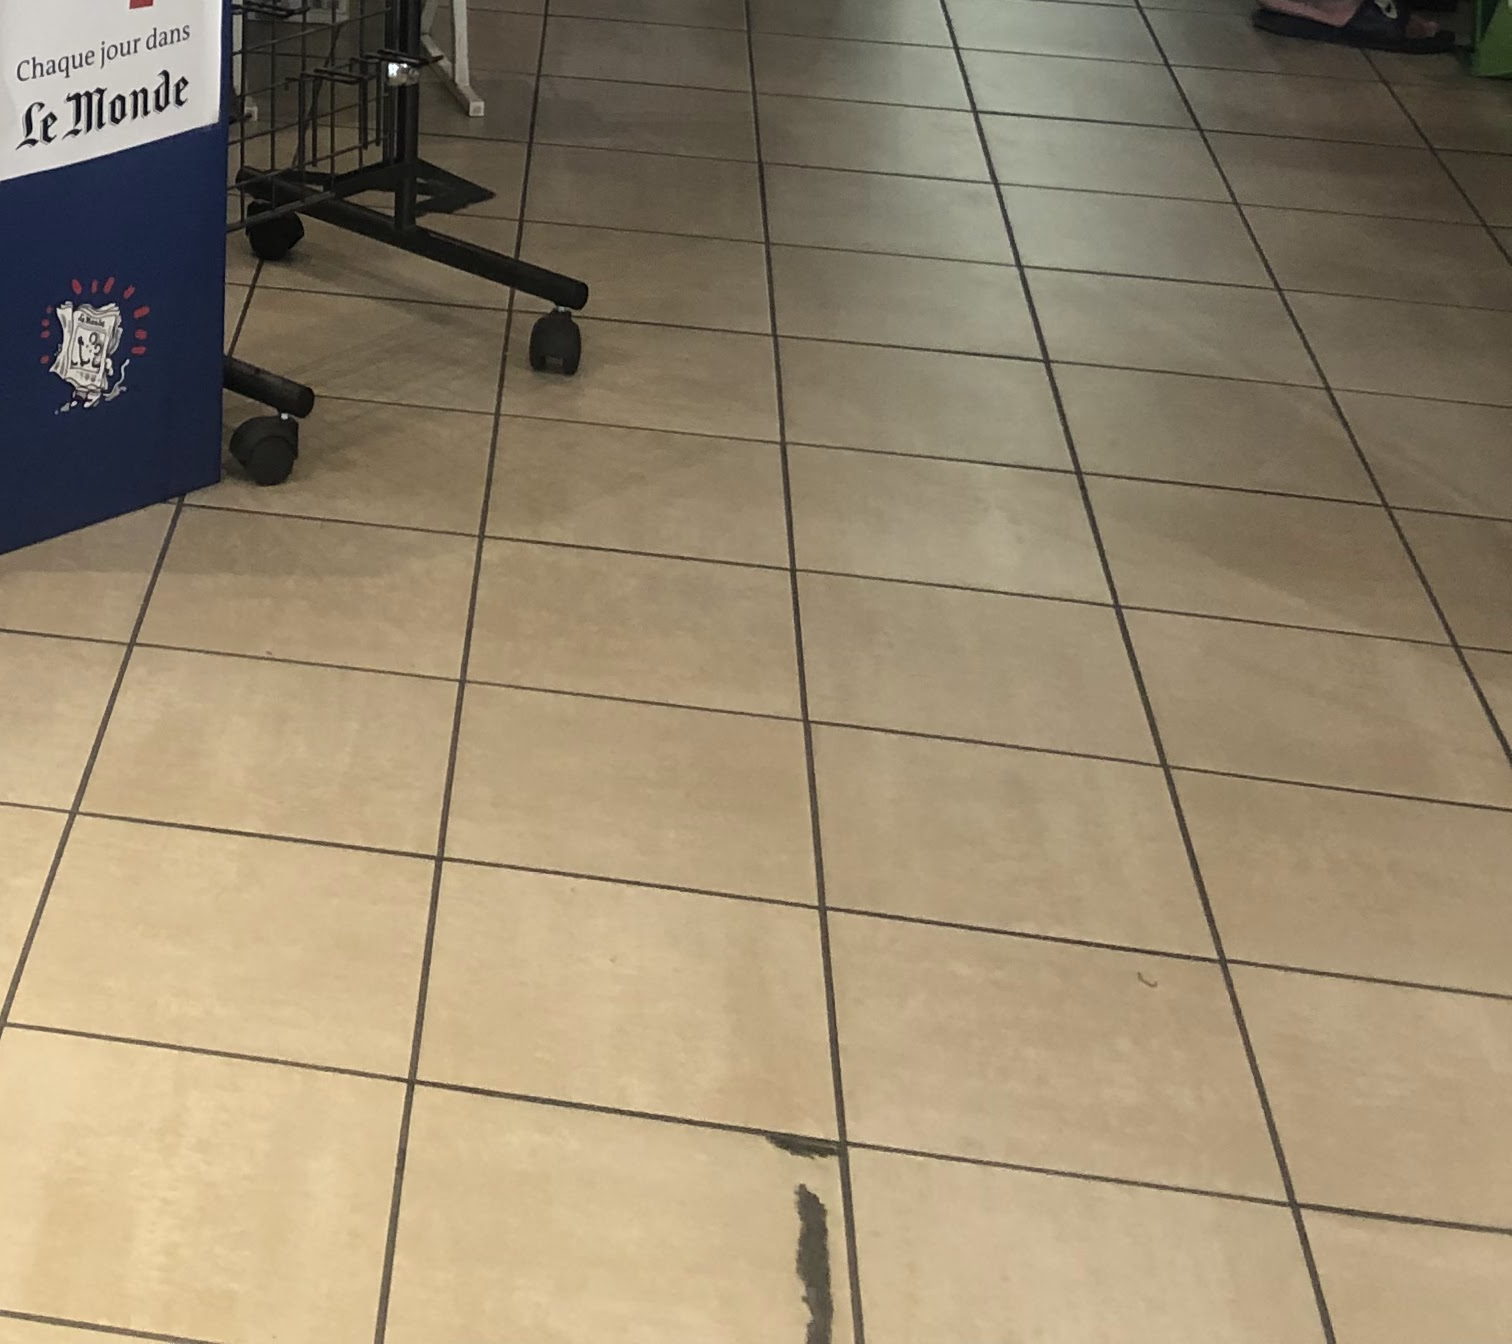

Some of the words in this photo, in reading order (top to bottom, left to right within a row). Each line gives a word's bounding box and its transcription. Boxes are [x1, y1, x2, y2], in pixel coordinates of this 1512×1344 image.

[16, 50, 96, 82] Chaque
[101, 38, 141, 69] jour
[145, 23, 191, 52] dans
[15, 100, 58, 151] Le
[62, 69, 189, 140] Monde
